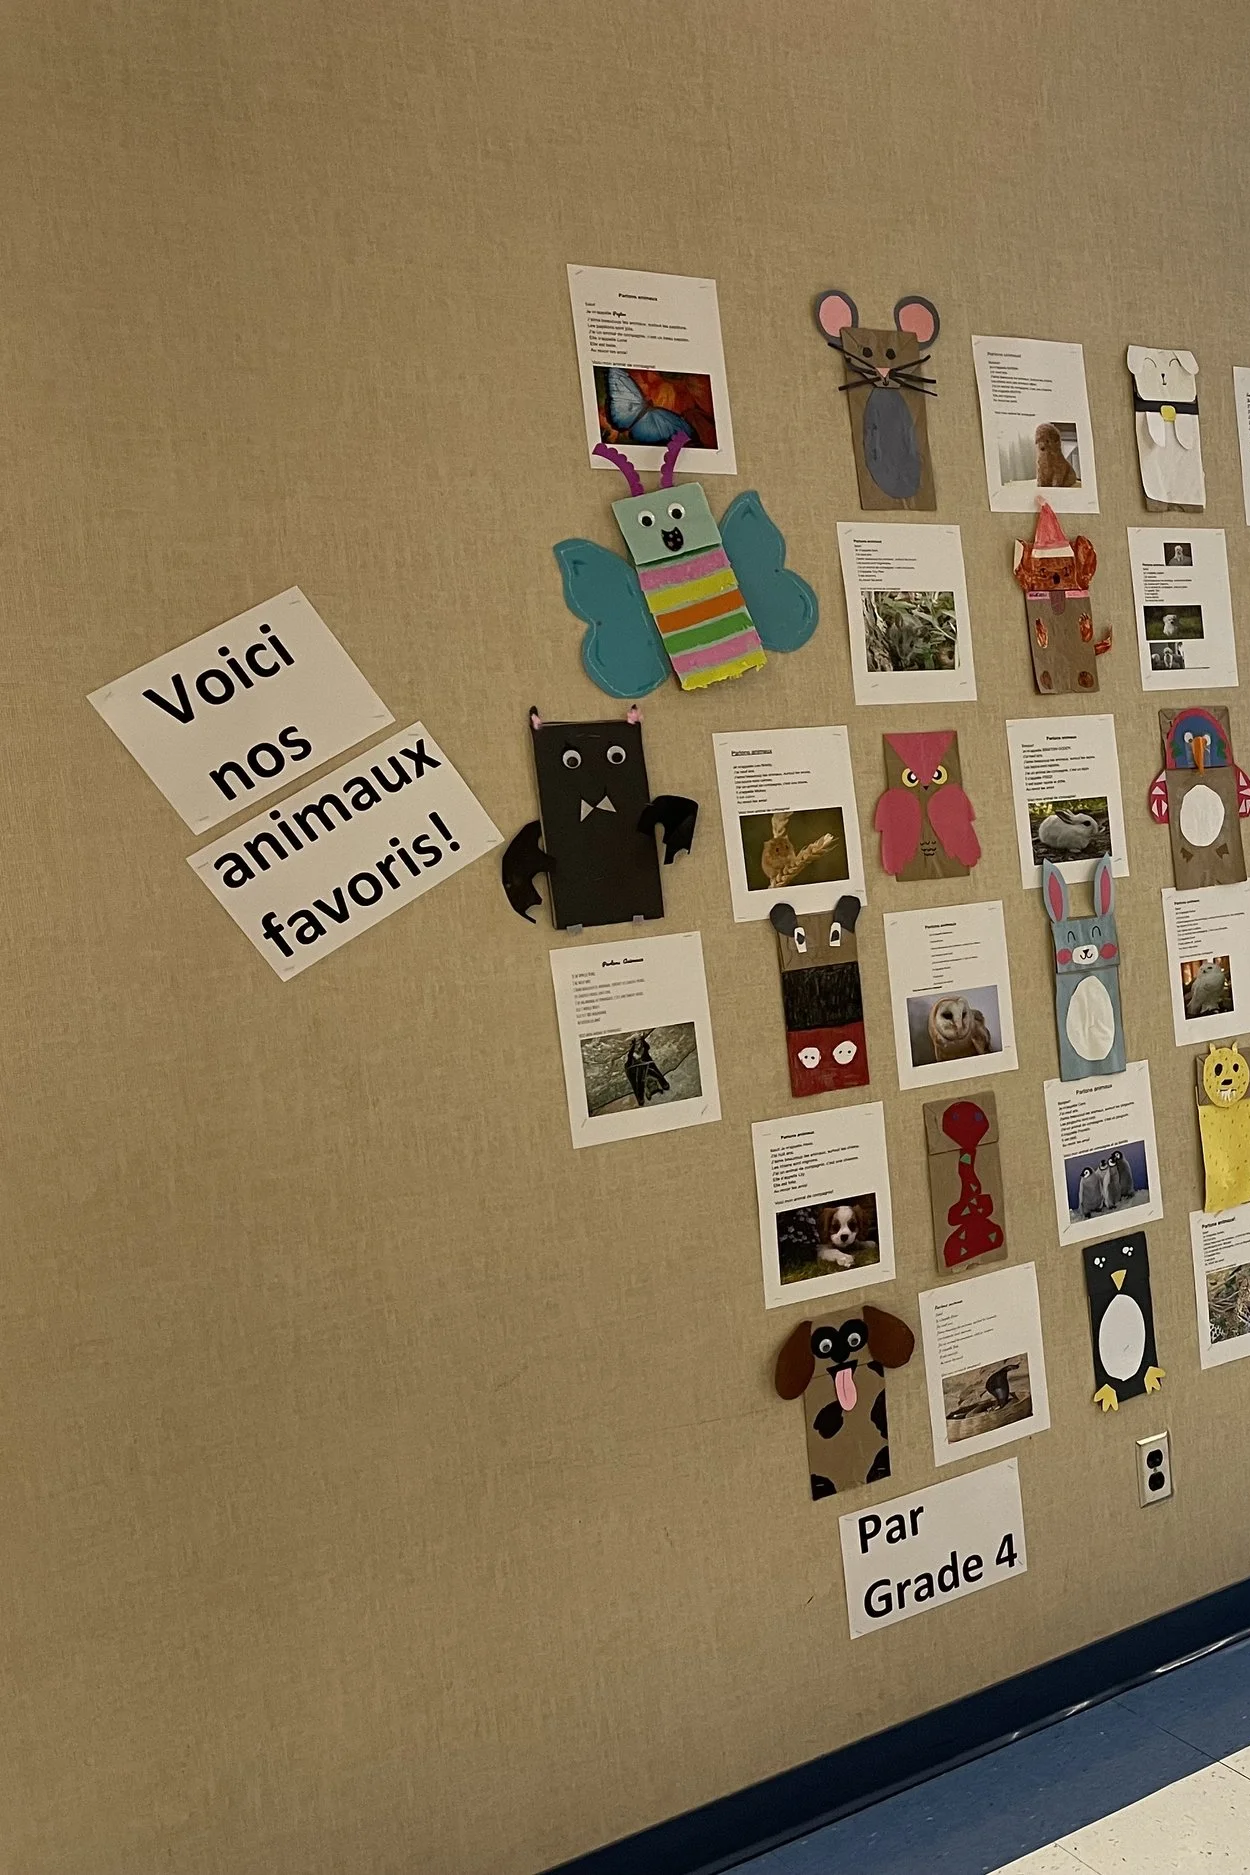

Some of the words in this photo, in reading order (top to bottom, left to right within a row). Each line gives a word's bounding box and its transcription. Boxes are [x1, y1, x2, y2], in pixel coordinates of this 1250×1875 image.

[142, 623, 295, 724] Voici
[208, 725, 313, 801] nos
[213, 738, 442, 889] animaux
[261, 811, 461, 958] favoris!
[858, 1506, 924, 1553] Par
[863, 1550, 983, 1618] Grade
[995, 1533, 1018, 1568] 4
